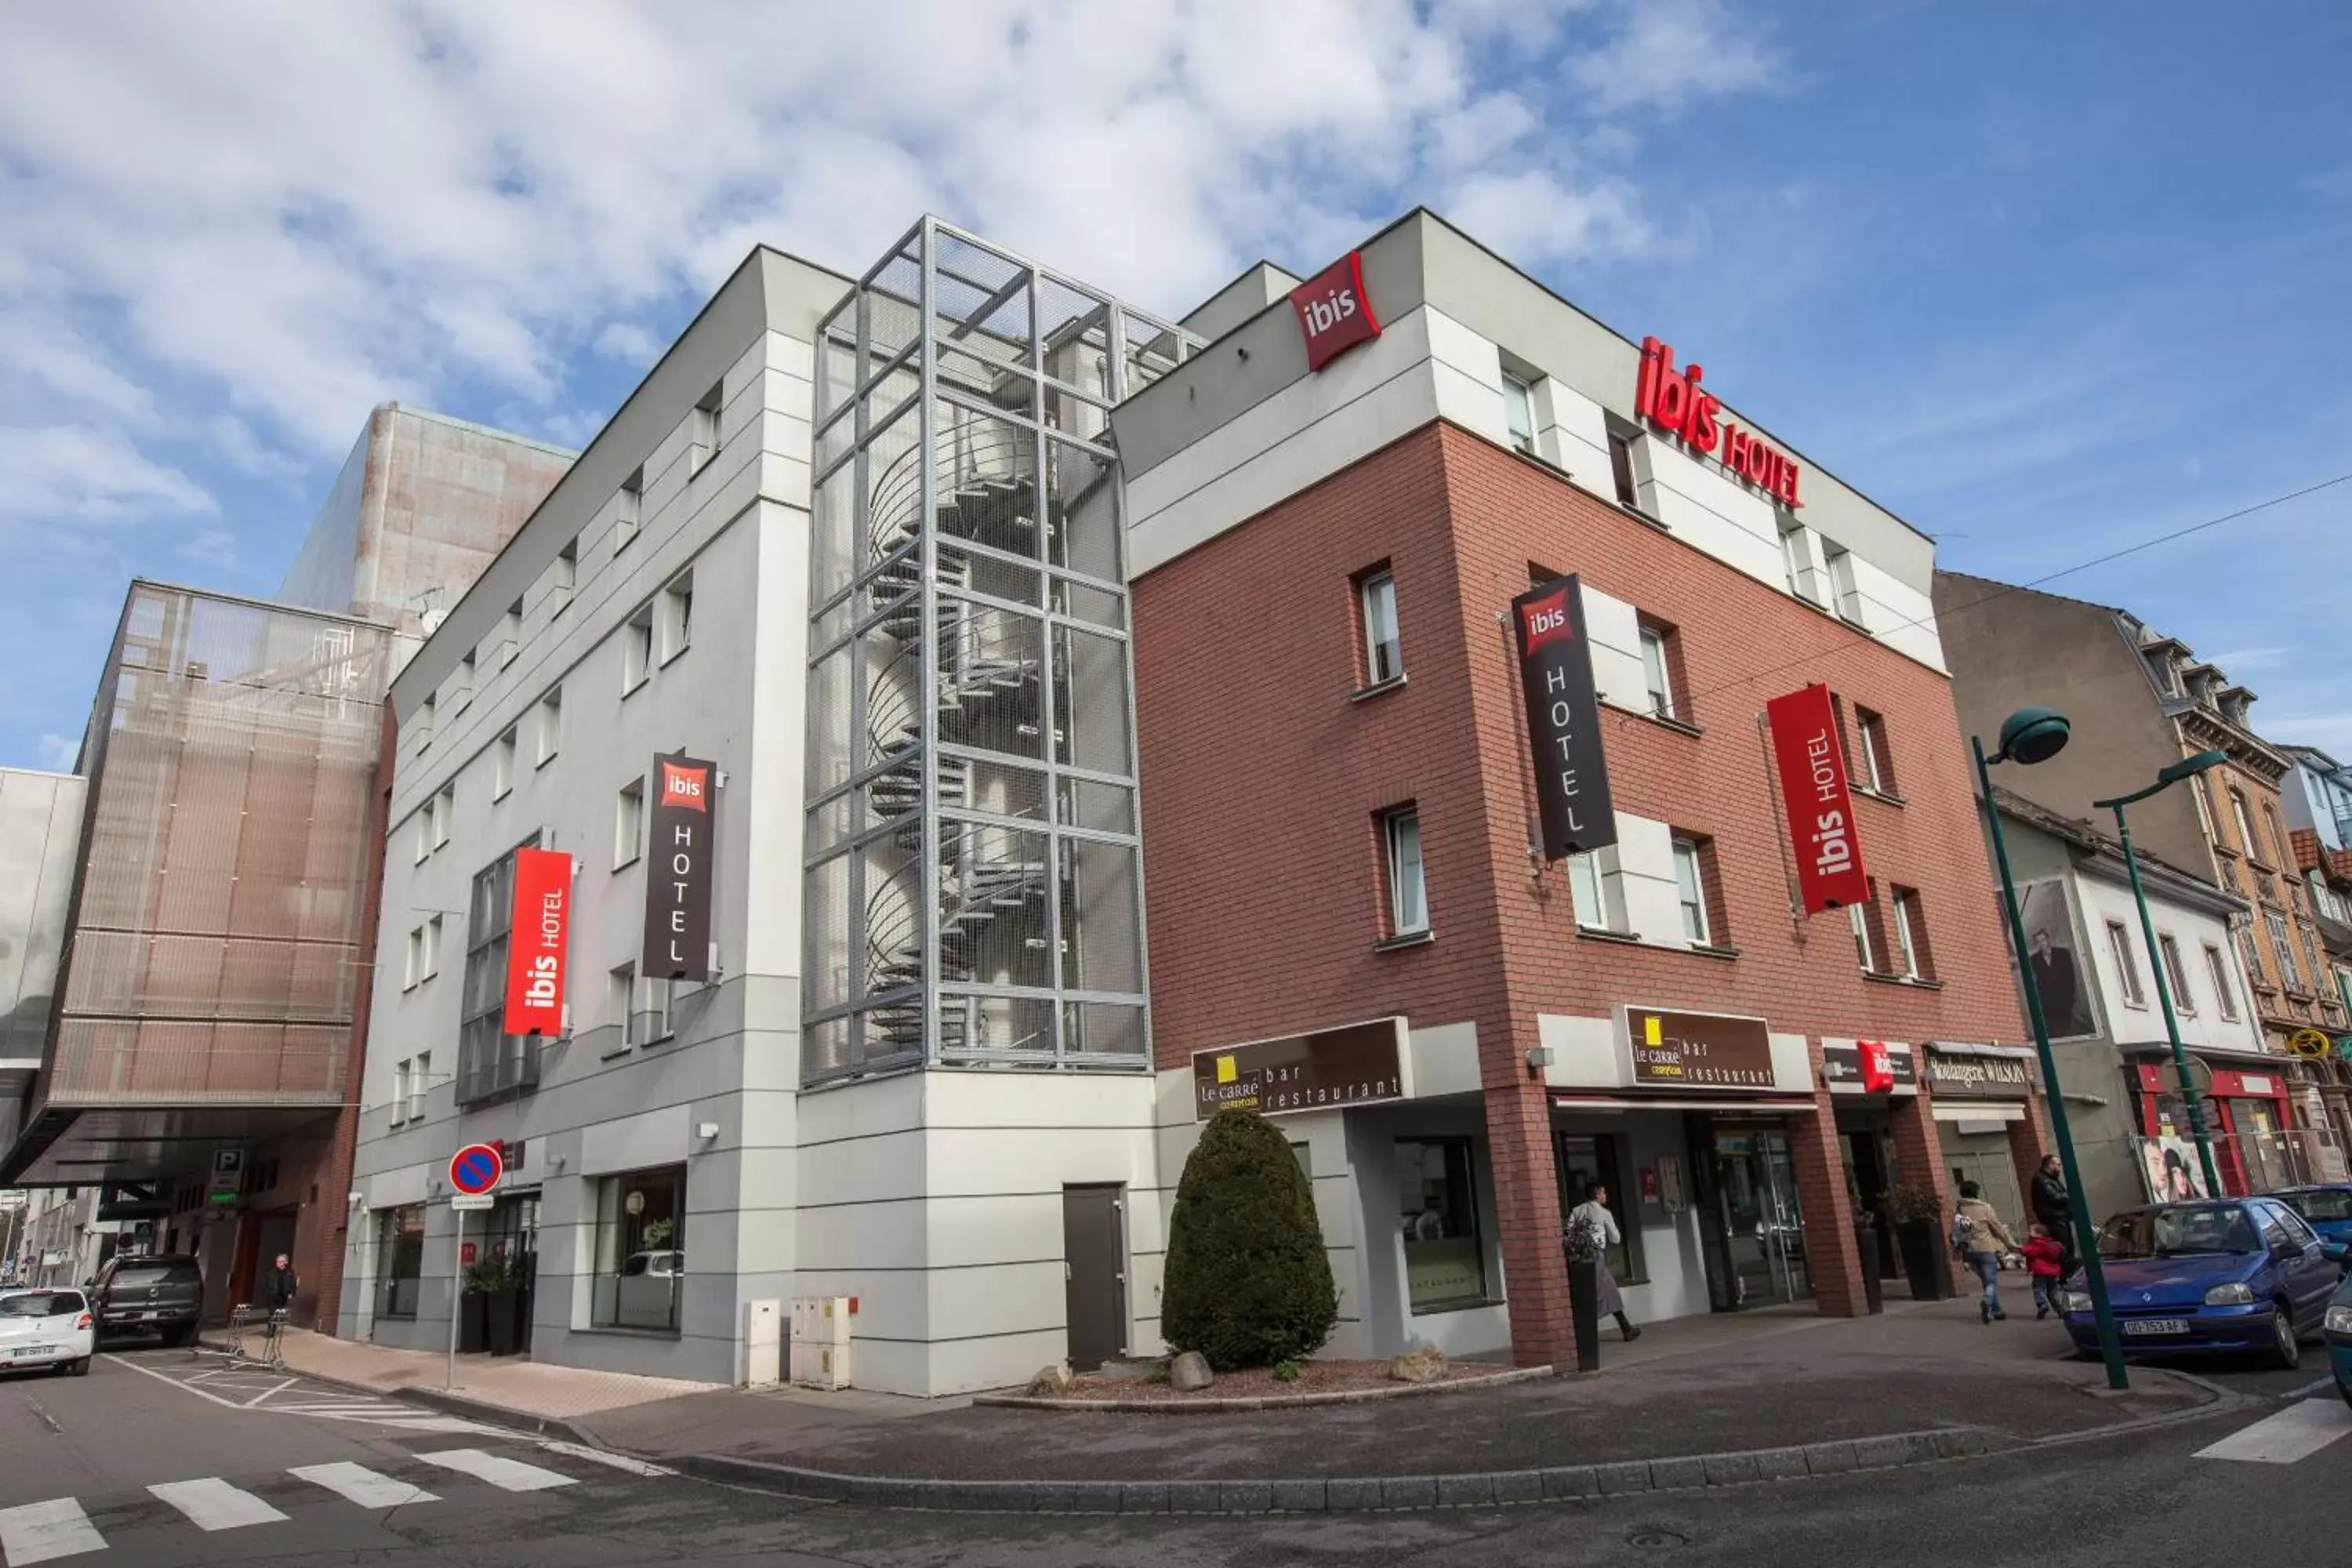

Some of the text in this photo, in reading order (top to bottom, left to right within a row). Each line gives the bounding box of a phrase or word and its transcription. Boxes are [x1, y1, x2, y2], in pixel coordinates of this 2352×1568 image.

[1304, 289, 1356, 338] ibis
[1634, 336, 1805, 508] ibis HOTEL
[1529, 608, 1566, 635] ibis
[1547, 665, 1584, 832] HOTEL
[668, 775, 700, 797] ibis
[1808, 728, 1851, 877] ibis HOTEL
[670, 824, 691, 963] HOTEL
[524, 887, 563, 1009] ibis HOTEL
[1266, 1065, 1300, 1083] bar
[1266, 1076, 1399, 1109] restaurant
[220, 1152, 236, 1170] P
